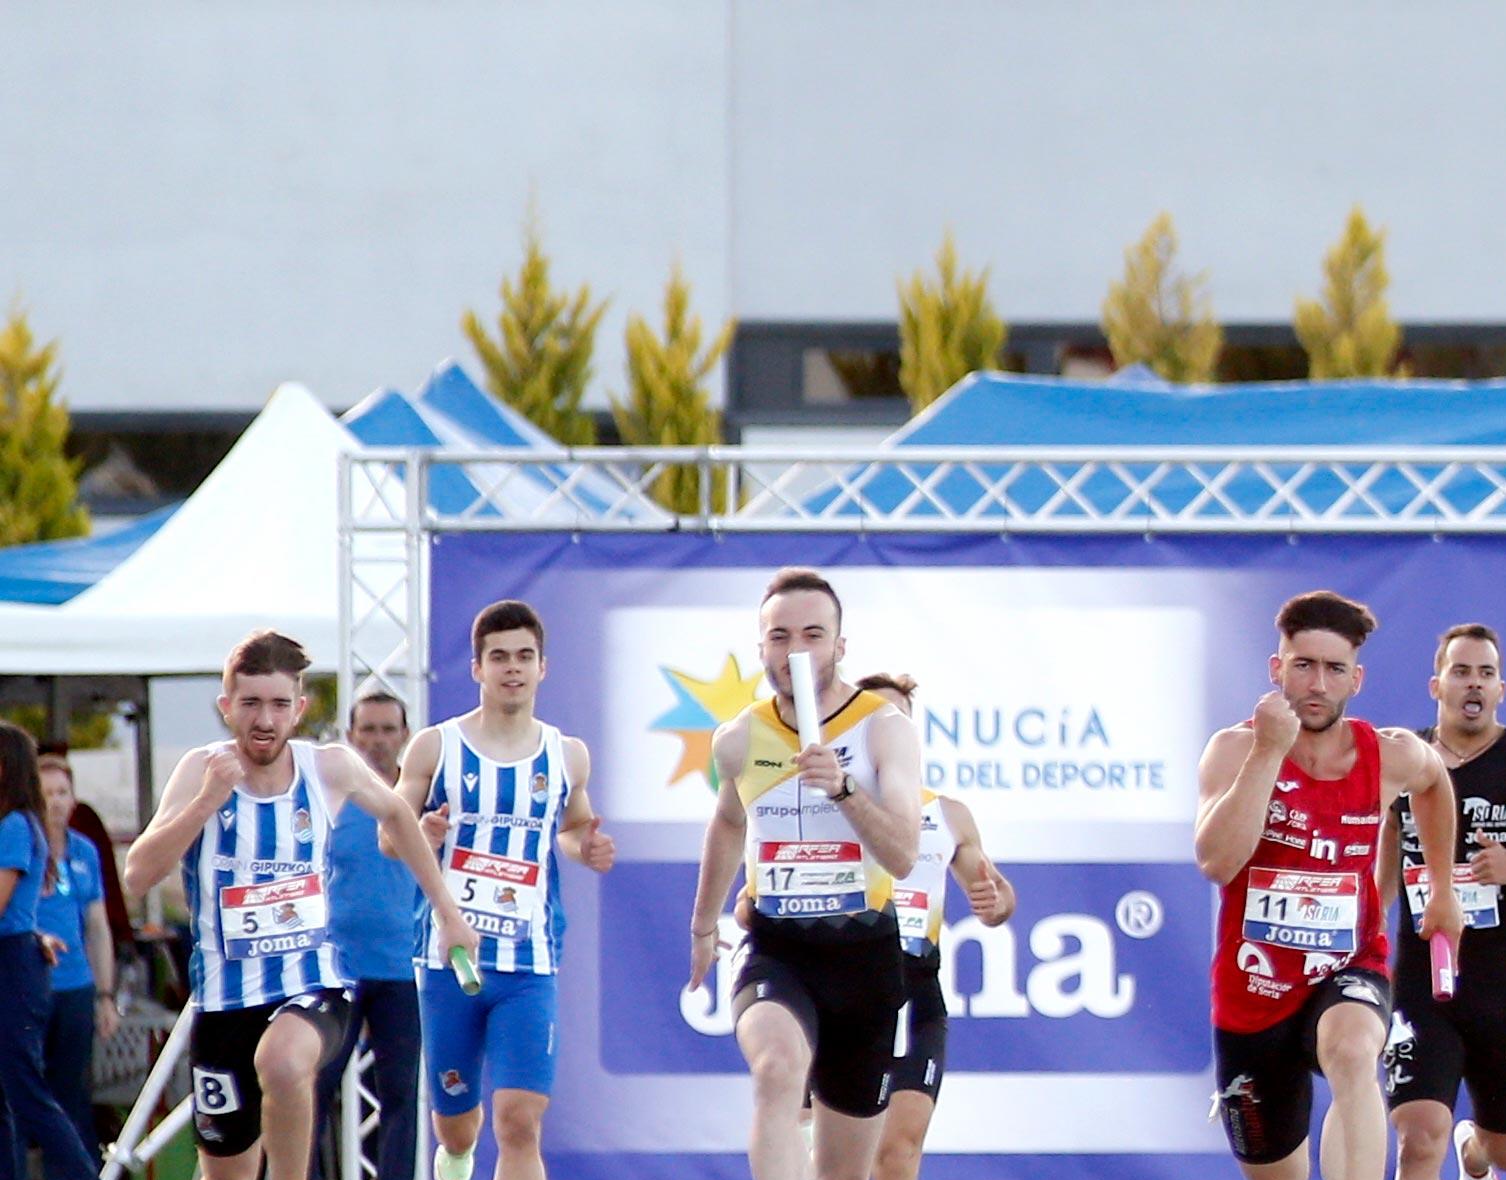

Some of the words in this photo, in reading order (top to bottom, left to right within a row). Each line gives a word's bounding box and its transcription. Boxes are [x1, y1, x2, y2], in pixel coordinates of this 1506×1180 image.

[956, 760, 1011, 789] DEL
[1022, 760, 1165, 790] DEPORTE
[250, 861, 314, 873] GIPUZKOA
[766, 867, 795, 891] 17
[461, 878, 477, 902] 5
[777, 897, 841, 915] Joma
[1258, 894, 1288, 921] 11
[242, 910, 258, 934] 5
[464, 911, 516, 935] oma
[1266, 926, 1332, 947] Joma
[201, 1077, 226, 1109] 8
